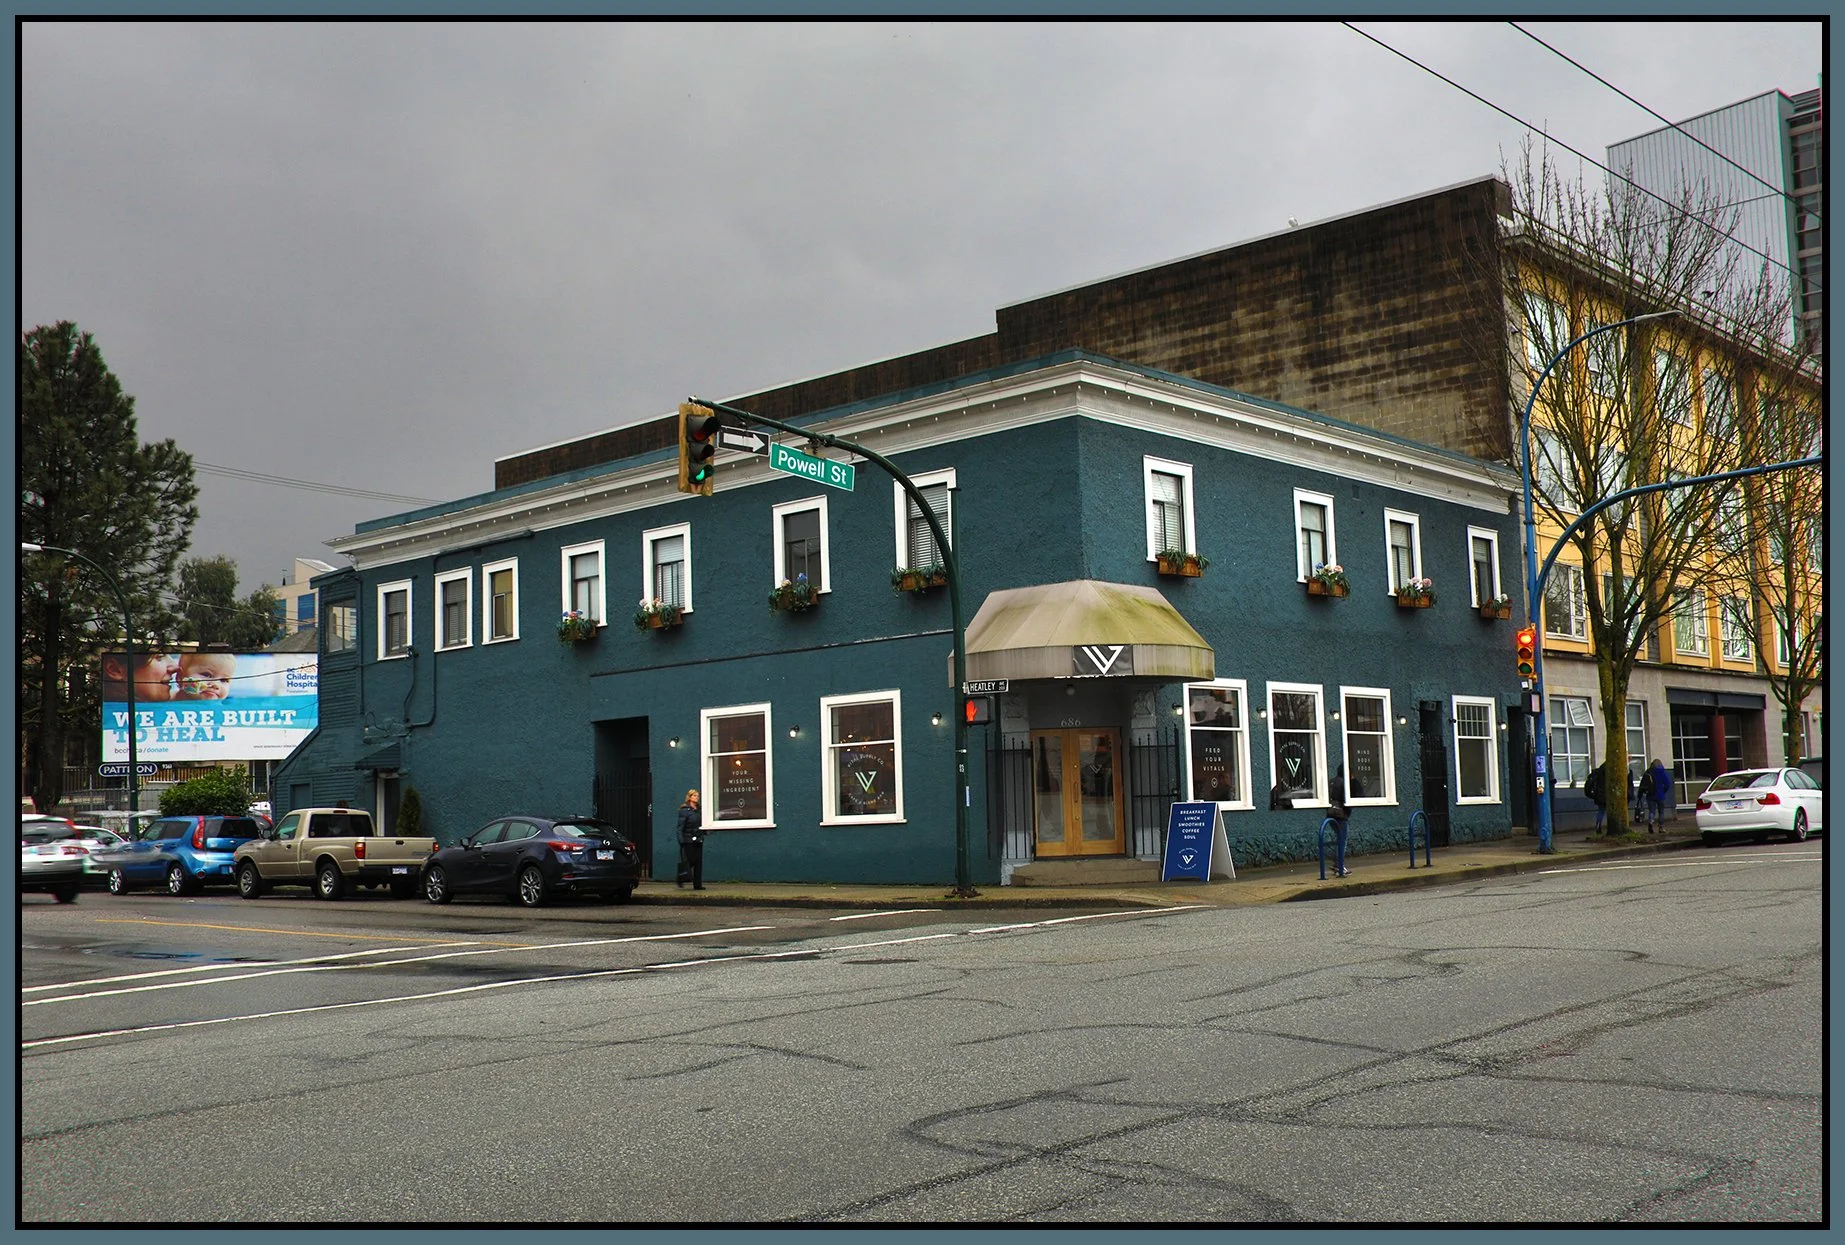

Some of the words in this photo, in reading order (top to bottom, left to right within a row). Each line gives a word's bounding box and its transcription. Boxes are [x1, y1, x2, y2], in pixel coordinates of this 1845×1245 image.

[778, 450, 825, 478] Powell
[831, 466, 847, 485] St
[286, 681, 320, 689] Hospita
[970, 682, 996, 692] HEATLEY
[162, 710, 214, 727] ARE
[222, 710, 297, 727] BUILT
[1060, 717, 1081, 728] 686
[156, 727, 225, 743] HEAL
[103, 765, 153, 774] PATTION
